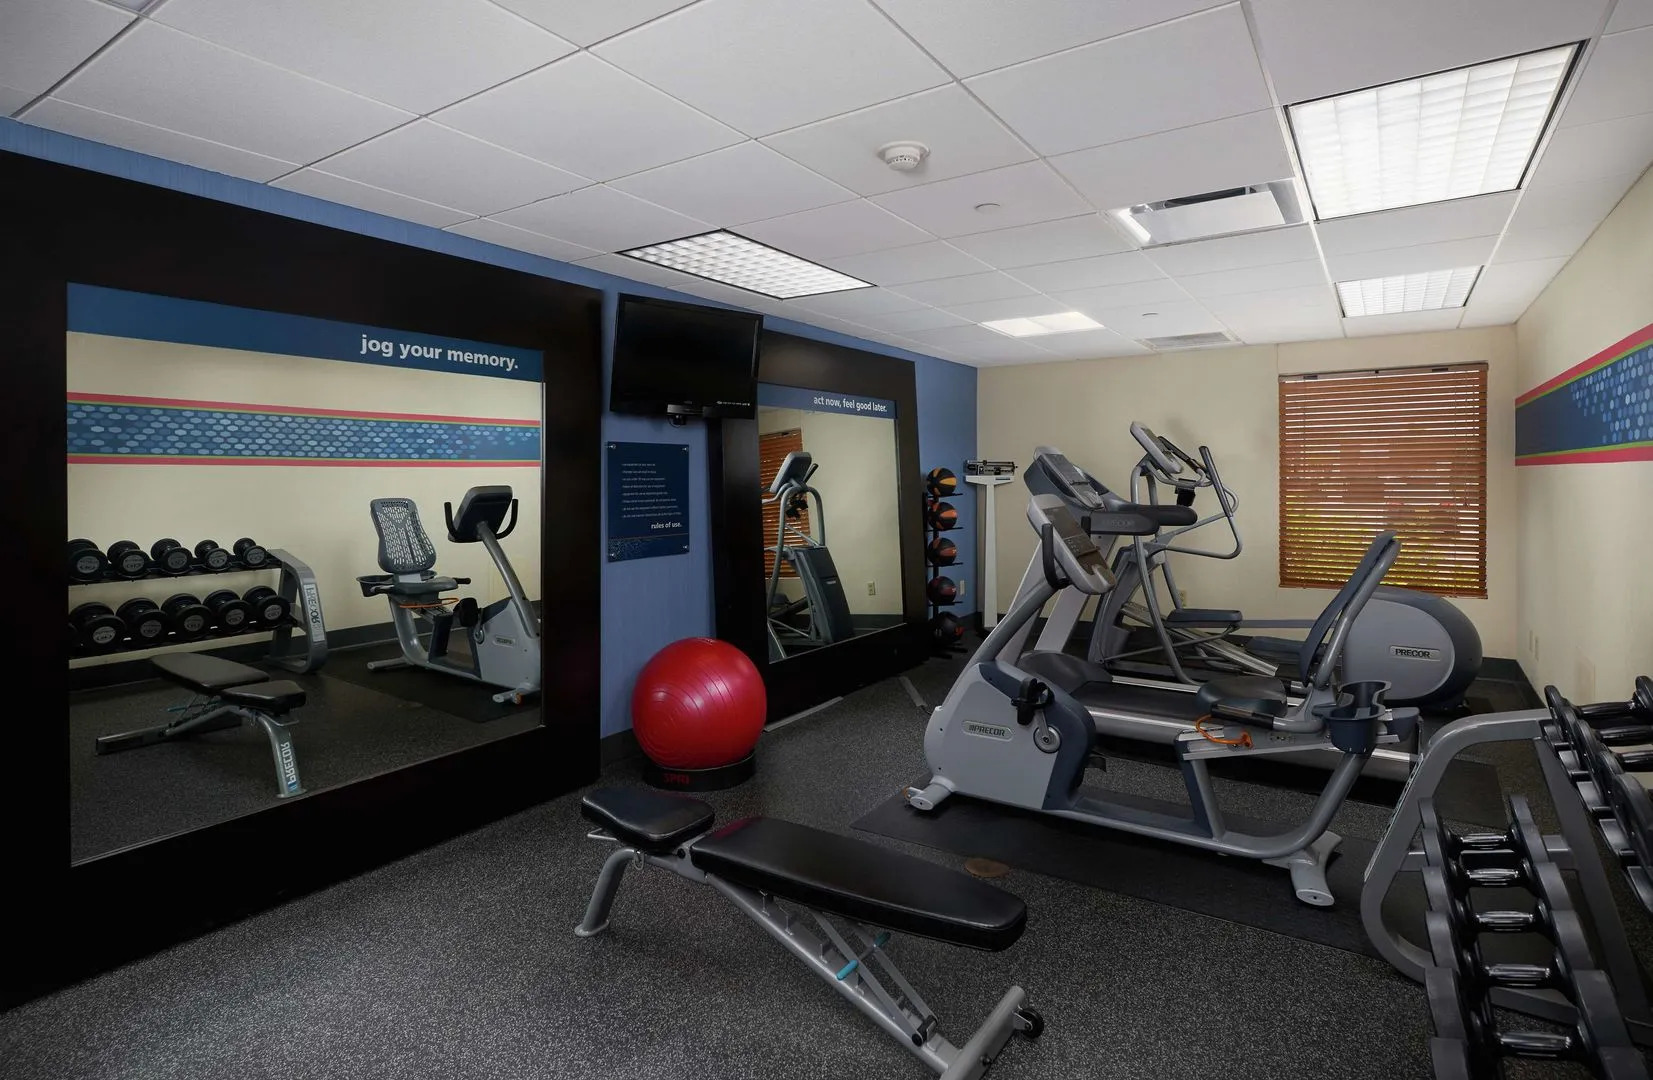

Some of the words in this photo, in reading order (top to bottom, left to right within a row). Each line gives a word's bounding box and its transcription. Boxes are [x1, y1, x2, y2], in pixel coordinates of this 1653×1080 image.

[360, 334, 393, 357] jog
[399, 343, 442, 359] your
[447, 349, 519, 371] memory.
[813, 396, 824, 405] act
[825, 398, 842, 408] now,
[843, 398, 855, 409] feel
[856, 401, 872, 412] good
[872, 402, 887, 413] later.
[1395, 648, 1431, 659] PRECOR
[974, 726, 1005, 736] PRECOR
